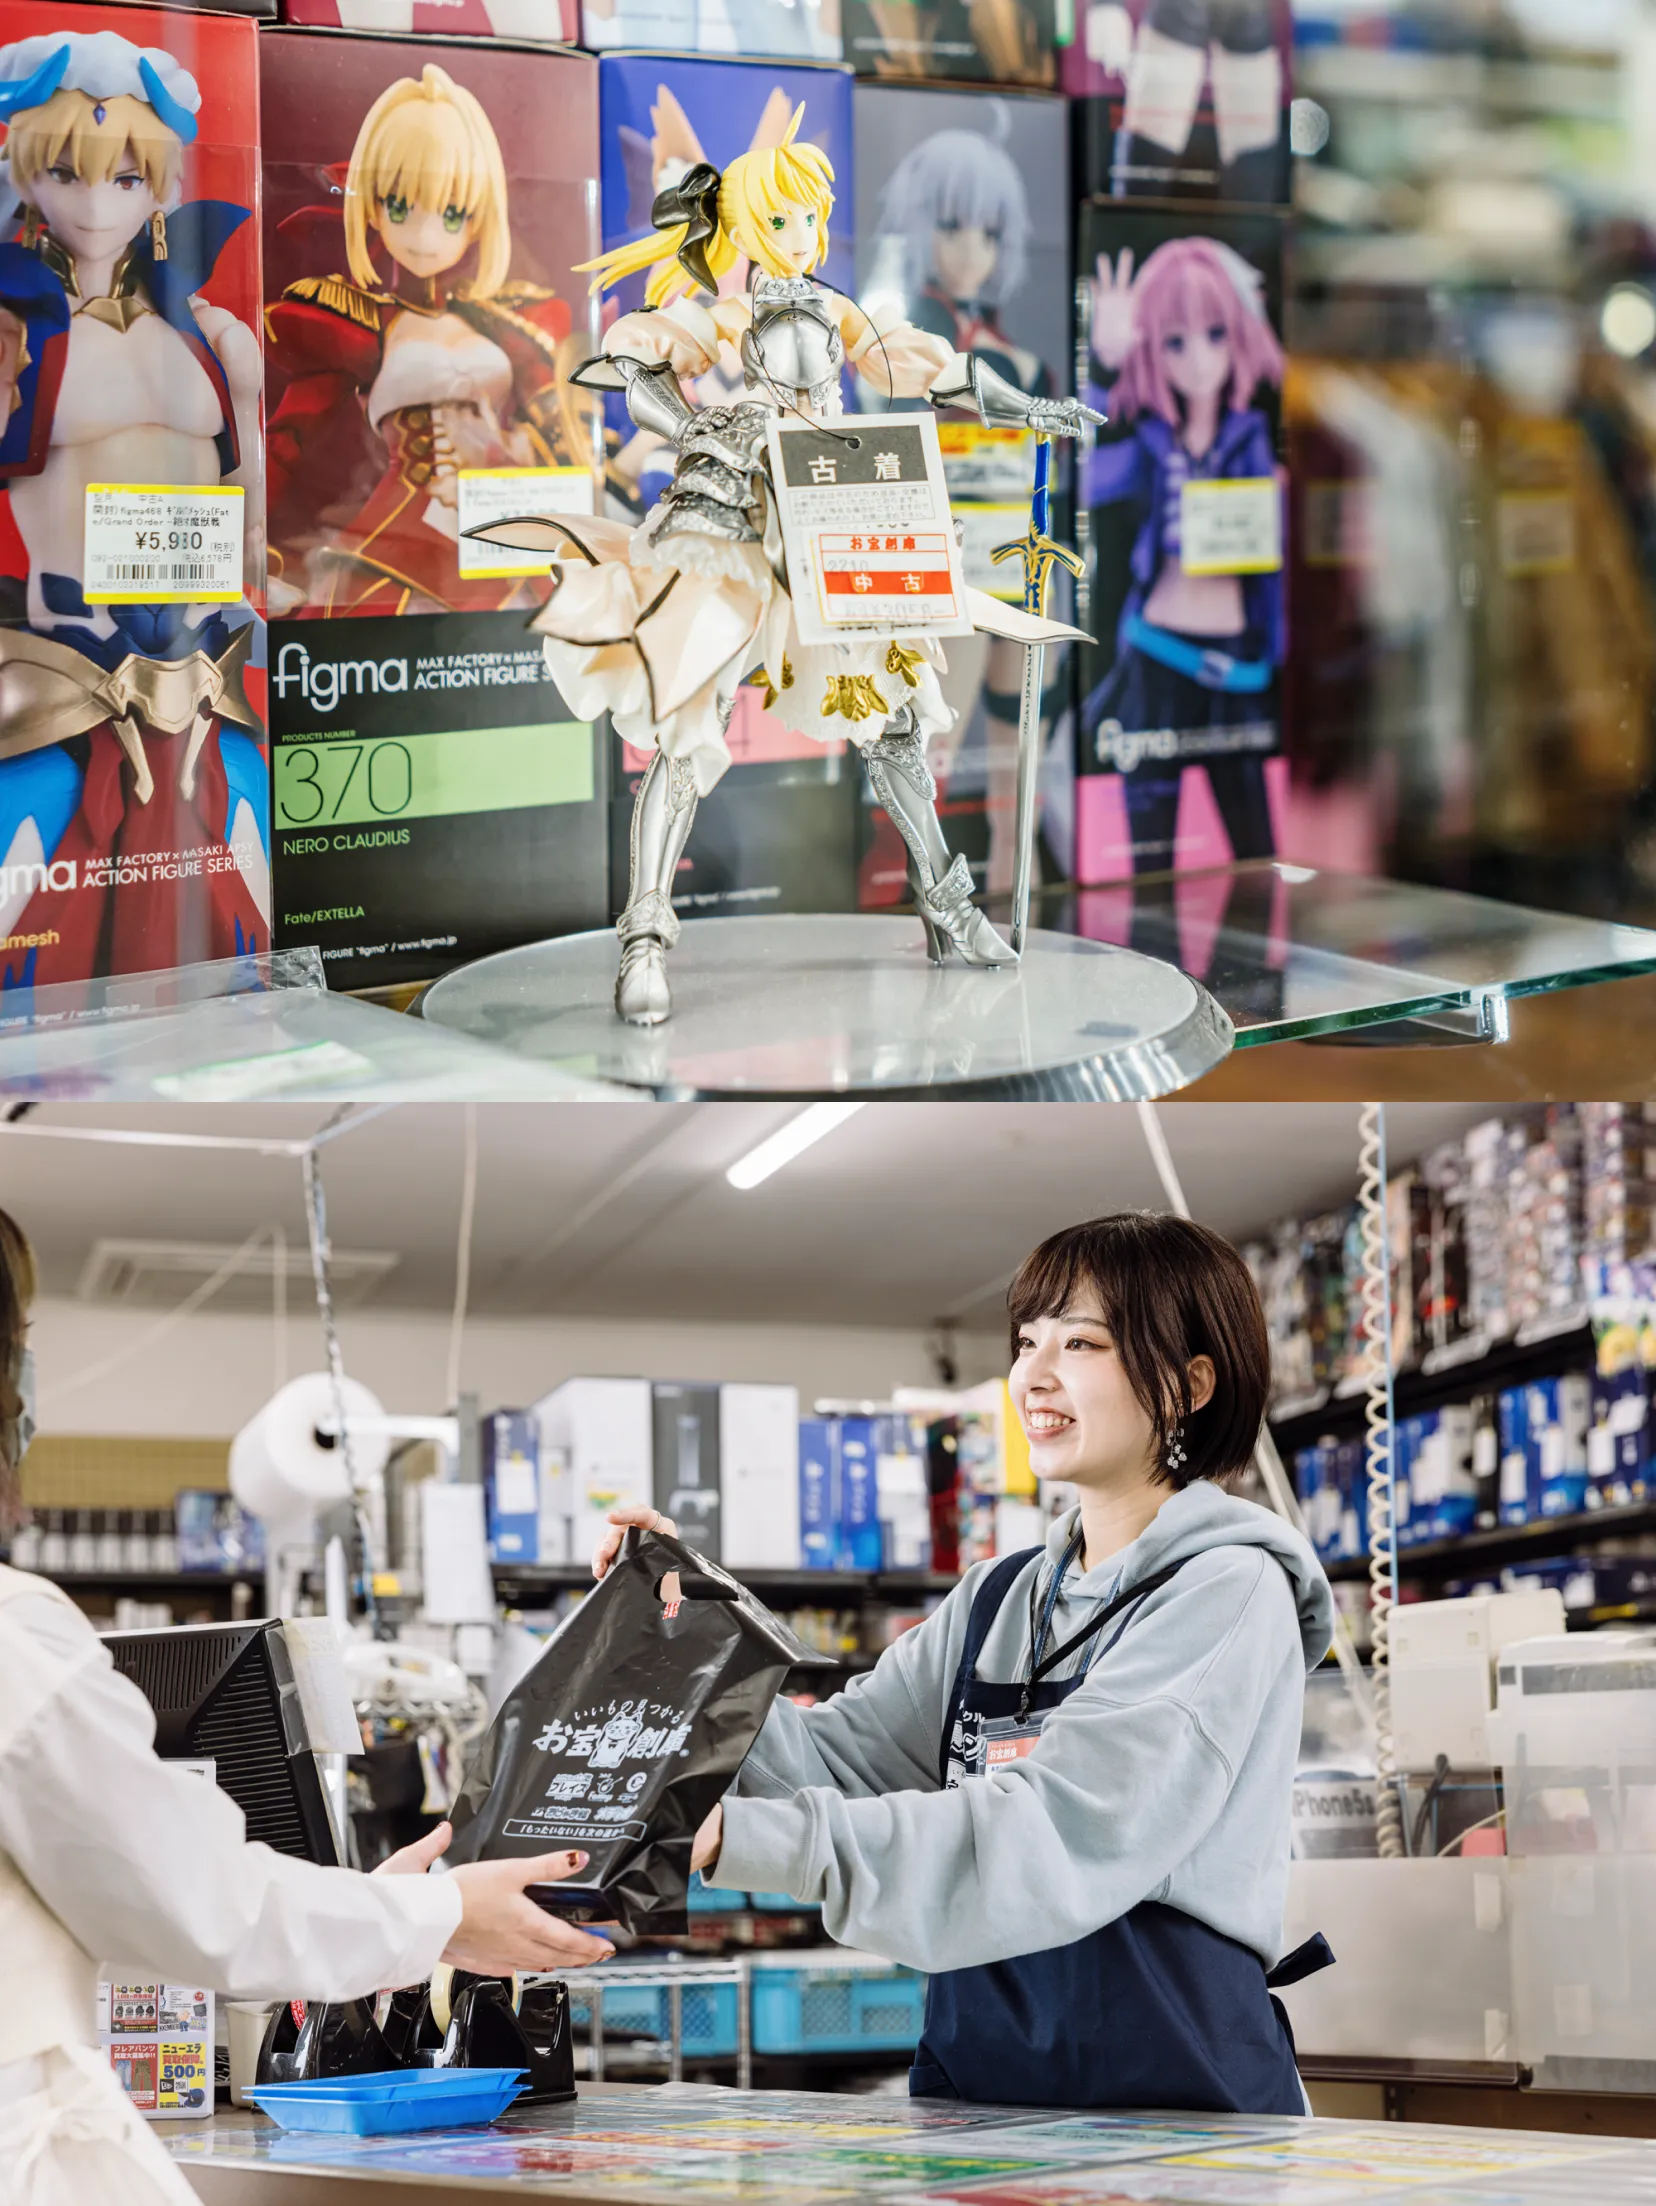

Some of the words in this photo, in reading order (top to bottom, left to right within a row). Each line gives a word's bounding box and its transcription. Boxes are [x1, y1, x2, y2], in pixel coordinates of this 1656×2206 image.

[414, 668, 480, 690] ACTION
[483, 663, 539, 686] FIGURE
[416, 657, 445, 670] MAX
[272, 642, 409, 713] figma
[282, 732, 323, 742] PRODUCTS
[324, 729, 356, 739] NUMBER
[280, 741, 412, 823] 370
[85, 857, 113, 870] MAX
[116, 852, 171, 868] FACTORY
[227, 842, 254, 855] APSY
[283, 836, 329, 856] NERO
[333, 829, 411, 850] CLAUDIUS
[82, 867, 148, 889] ACTION
[152, 860, 202, 881] FIGURE
[207, 854, 254, 874] SERIES
[284, 906, 365, 925] Fate/EXTELLA
[162, 2043, 202, 2054] ニューエラ
